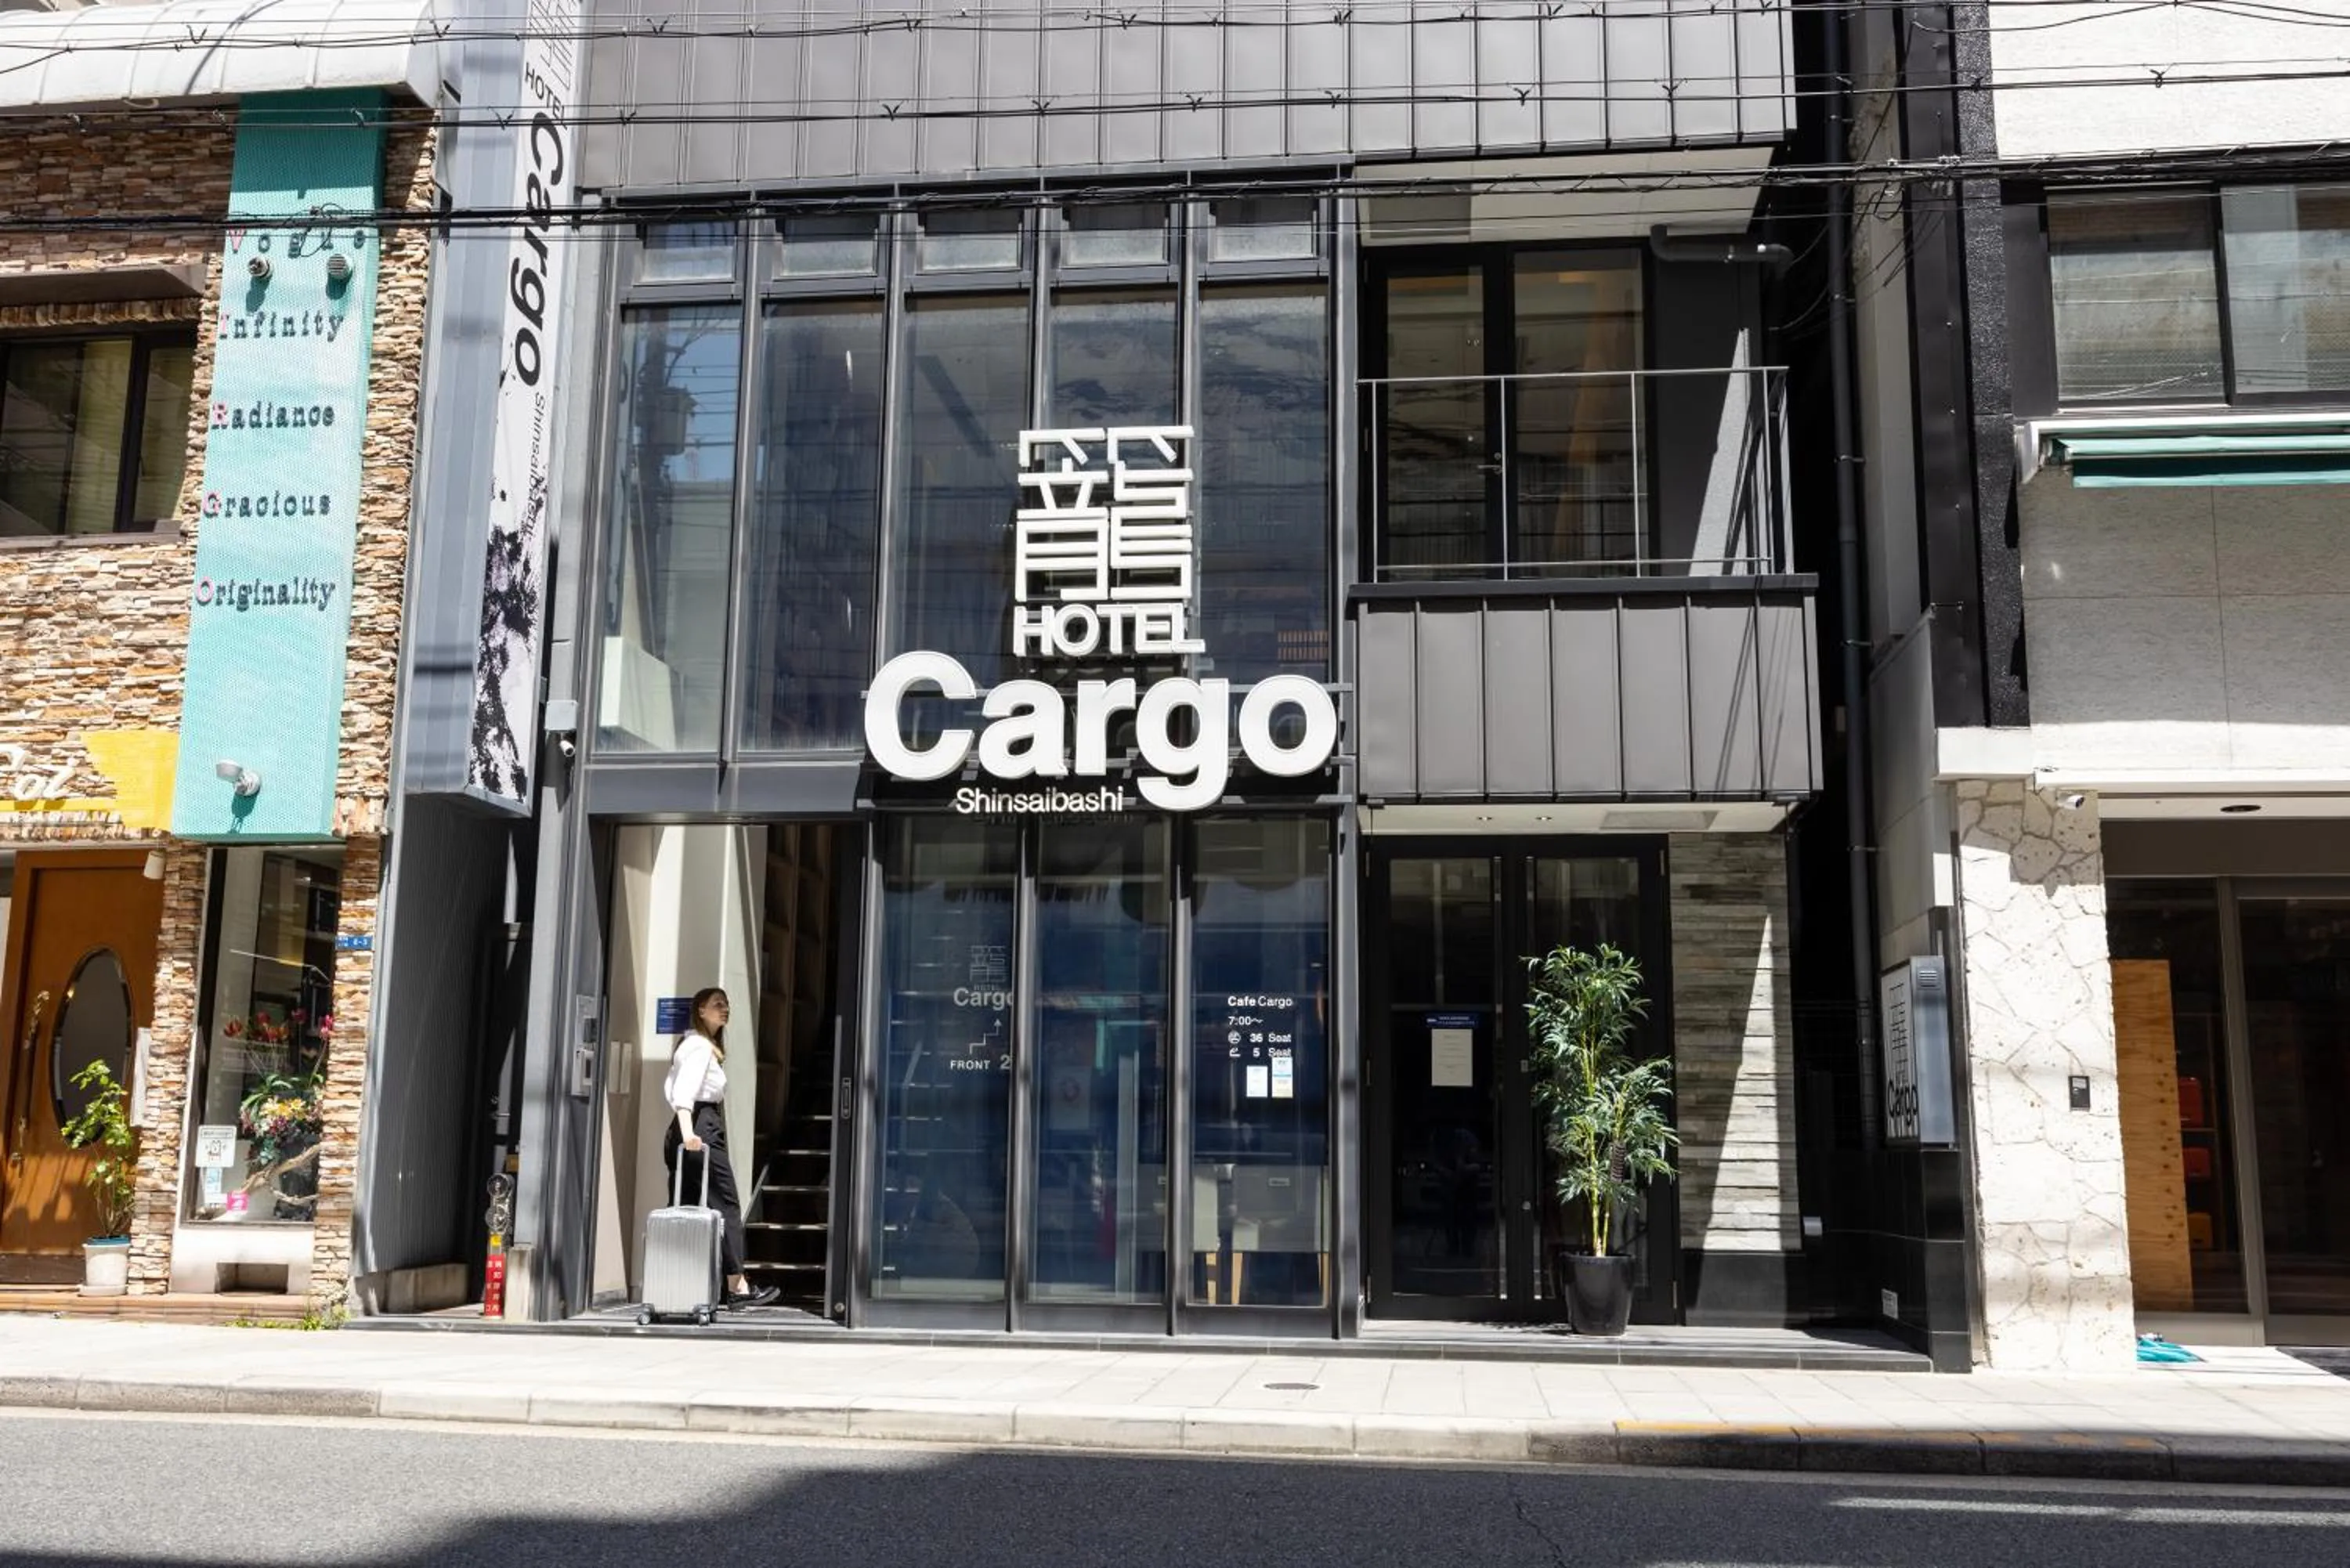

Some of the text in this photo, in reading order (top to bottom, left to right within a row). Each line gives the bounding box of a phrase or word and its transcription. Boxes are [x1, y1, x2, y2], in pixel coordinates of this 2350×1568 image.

[525, 62, 568, 131] HOTEL
[511, 112, 564, 386] Cargo
[219, 310, 344, 343] Infinity
[211, 400, 335, 430] Radiance
[202, 489, 332, 518] Gracious
[196, 576, 337, 612] Originality
[1013, 602, 1206, 657] HOTEL
[864, 650, 1337, 811] Cargo
[955, 786, 1123, 814] Shinsaibashi
[1227, 995, 1293, 1010] Cafe Cargo
[1268, 1032, 1292, 1042] Seat
[949, 1060, 991, 1071] FRONT
[1887, 1077, 1918, 1126] Cargo
